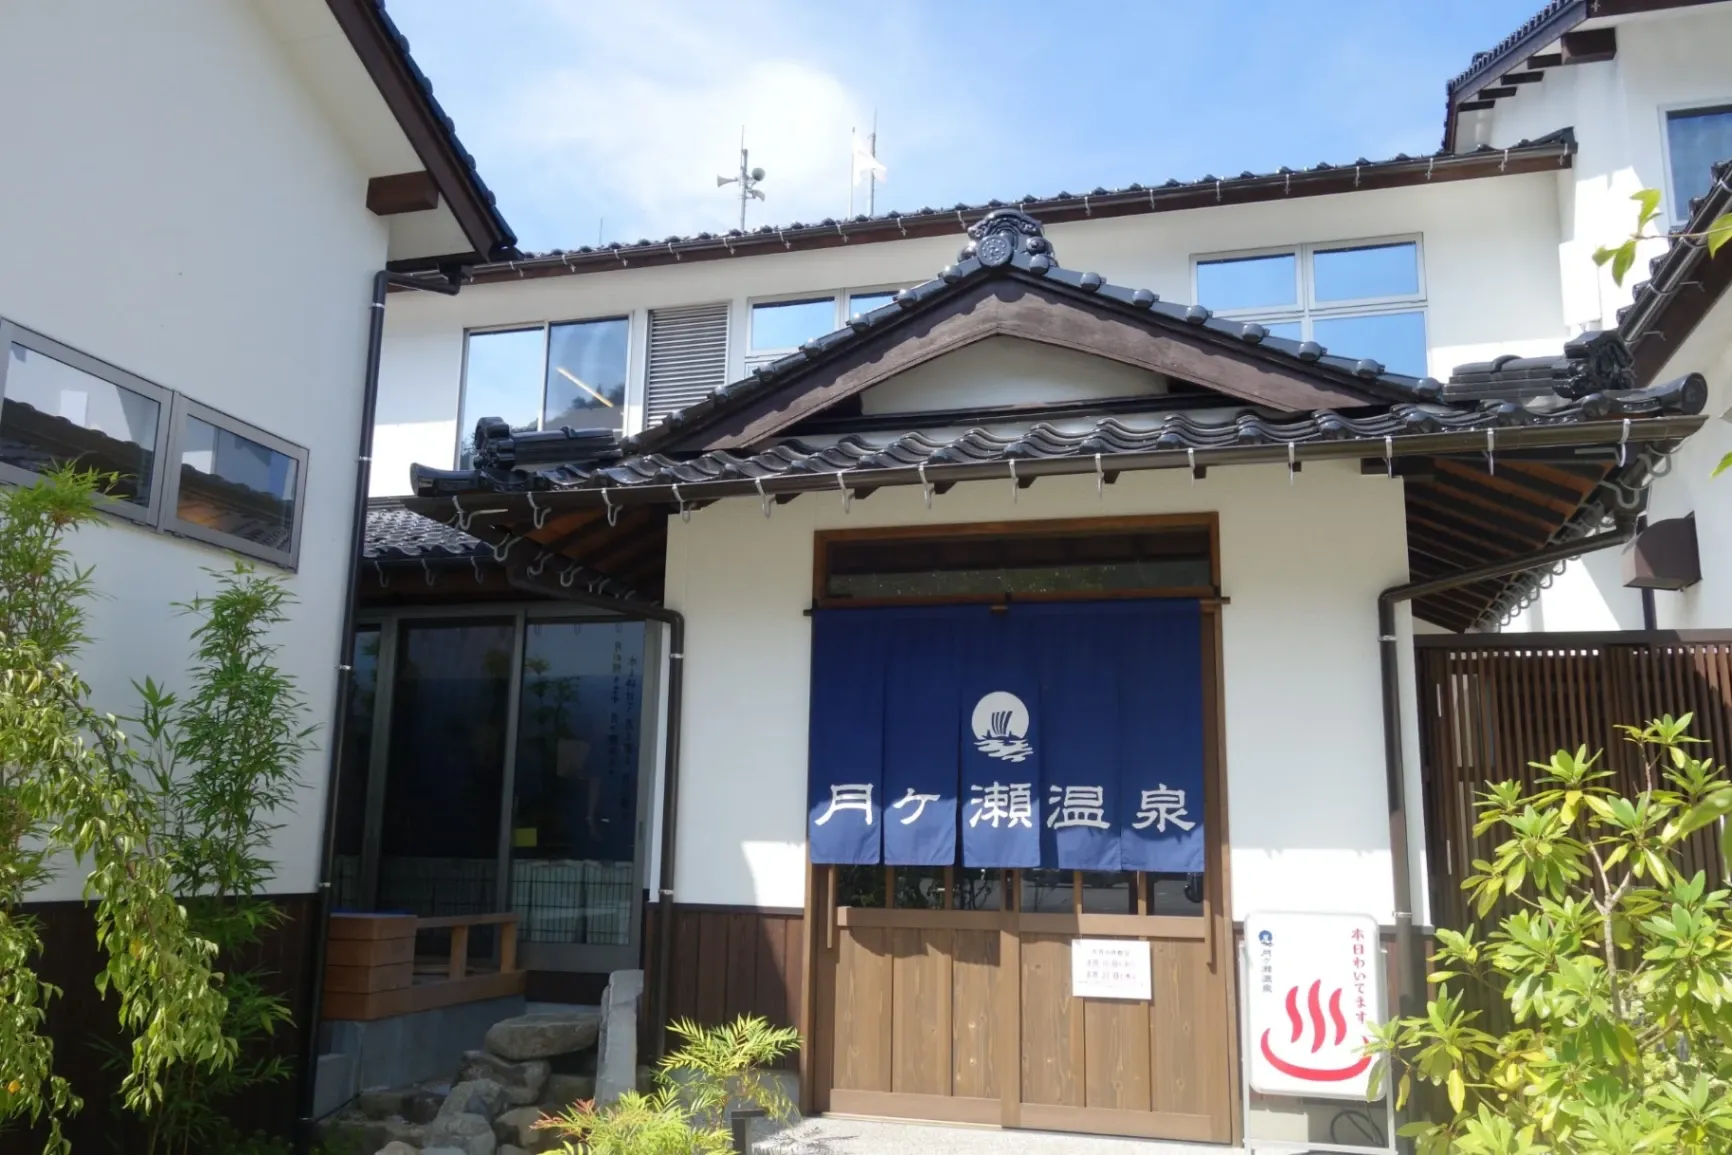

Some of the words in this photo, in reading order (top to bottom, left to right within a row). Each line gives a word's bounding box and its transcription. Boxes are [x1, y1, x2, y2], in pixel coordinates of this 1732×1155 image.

[1351, 928, 1368, 1025] 本日わいてます
